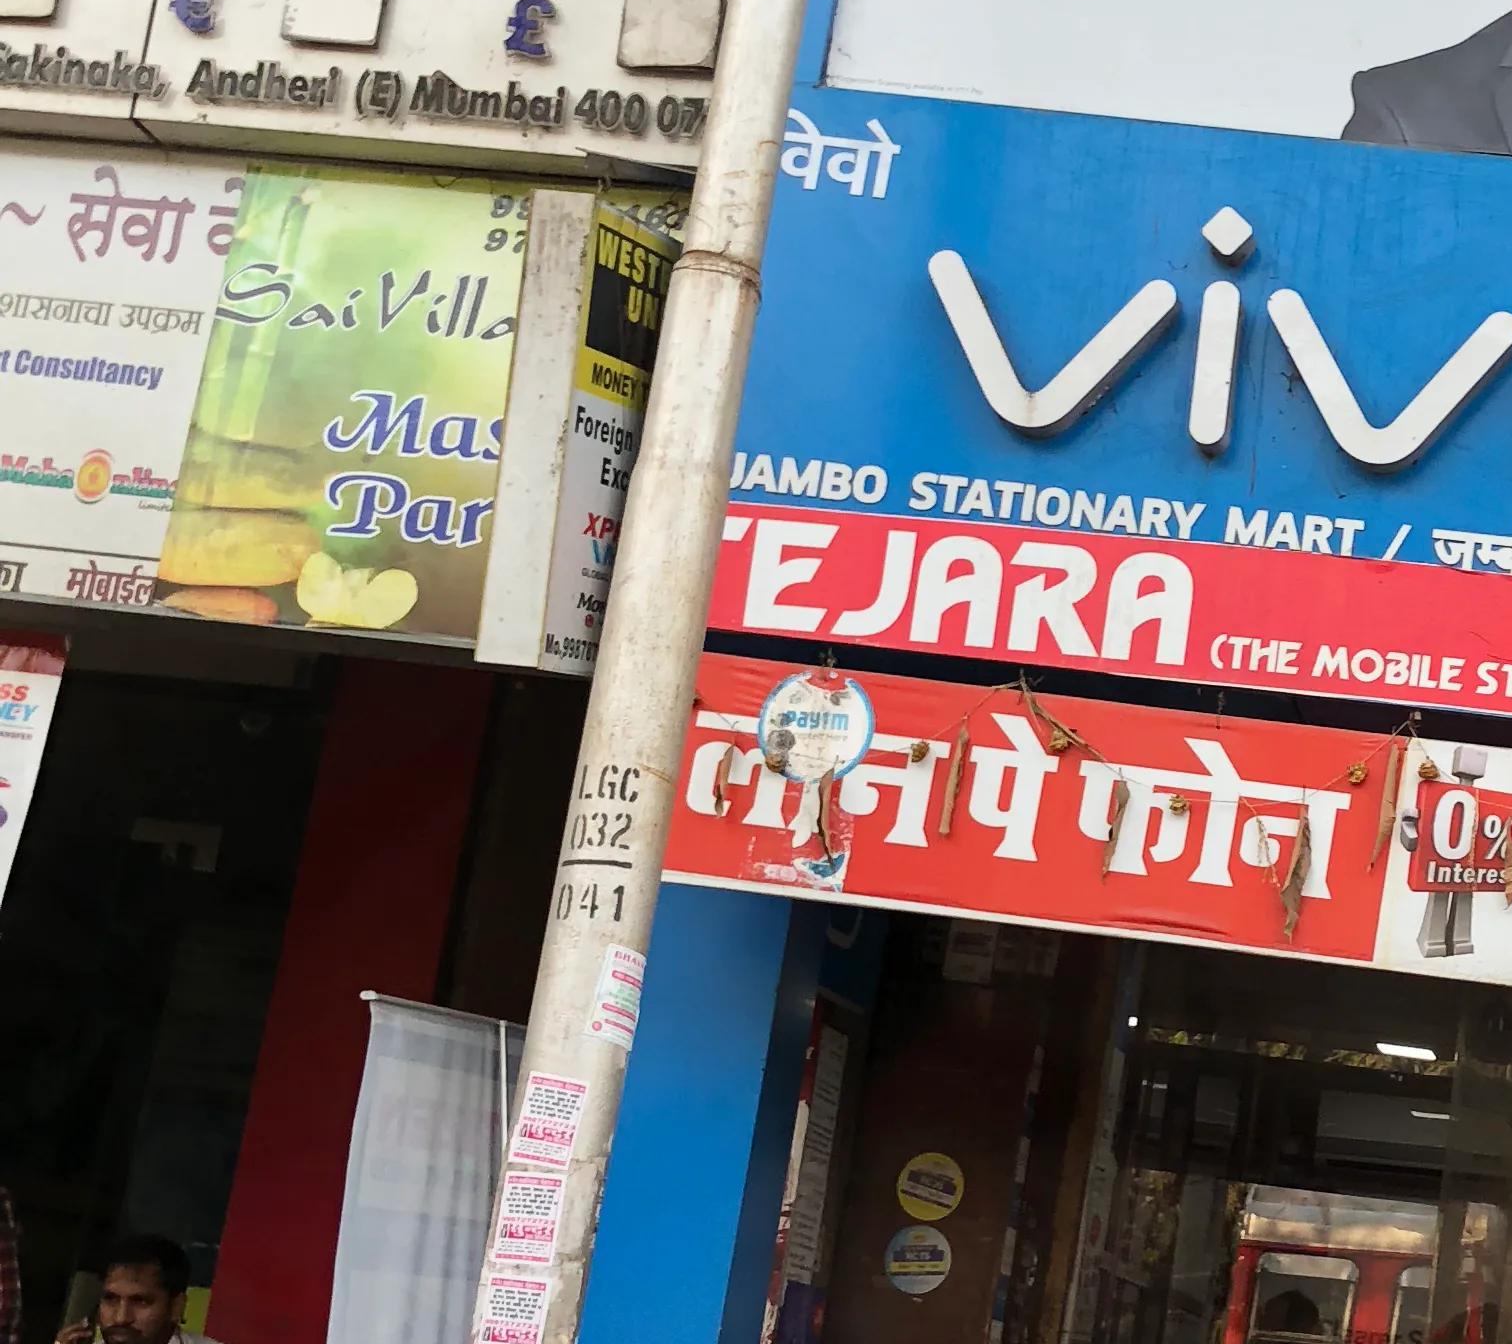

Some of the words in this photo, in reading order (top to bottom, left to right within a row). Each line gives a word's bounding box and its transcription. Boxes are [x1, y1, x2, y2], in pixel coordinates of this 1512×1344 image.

[186, 56, 342, 105] Andheri
[356, 69, 402, 120] (E)
[409, 73, 567, 127] Mumbai
[573, 88, 648, 134] 400
[67, 164, 196, 263] सेवा
[120, 302, 203, 336] उपक्रम
[215, 262, 363, 330] Sai
[14, 348, 165, 391] Consultancy
[591, 362, 639, 401] MONEY
[574, 405, 633, 456] Foreign
[729, 451, 889, 504] JAMBO
[908, 471, 1205, 541] STATIONARY
[1224, 506, 1366, 556] MART
[1210, 632, 1303, 675] (THE
[1311, 644, 1467, 692] MOBILE
[579, 764, 640, 803] LGC
[969, 712, 1057, 863] पे
[1077, 737, 1353, 902] फोन
[1426, 859, 1512, 887] Interes
